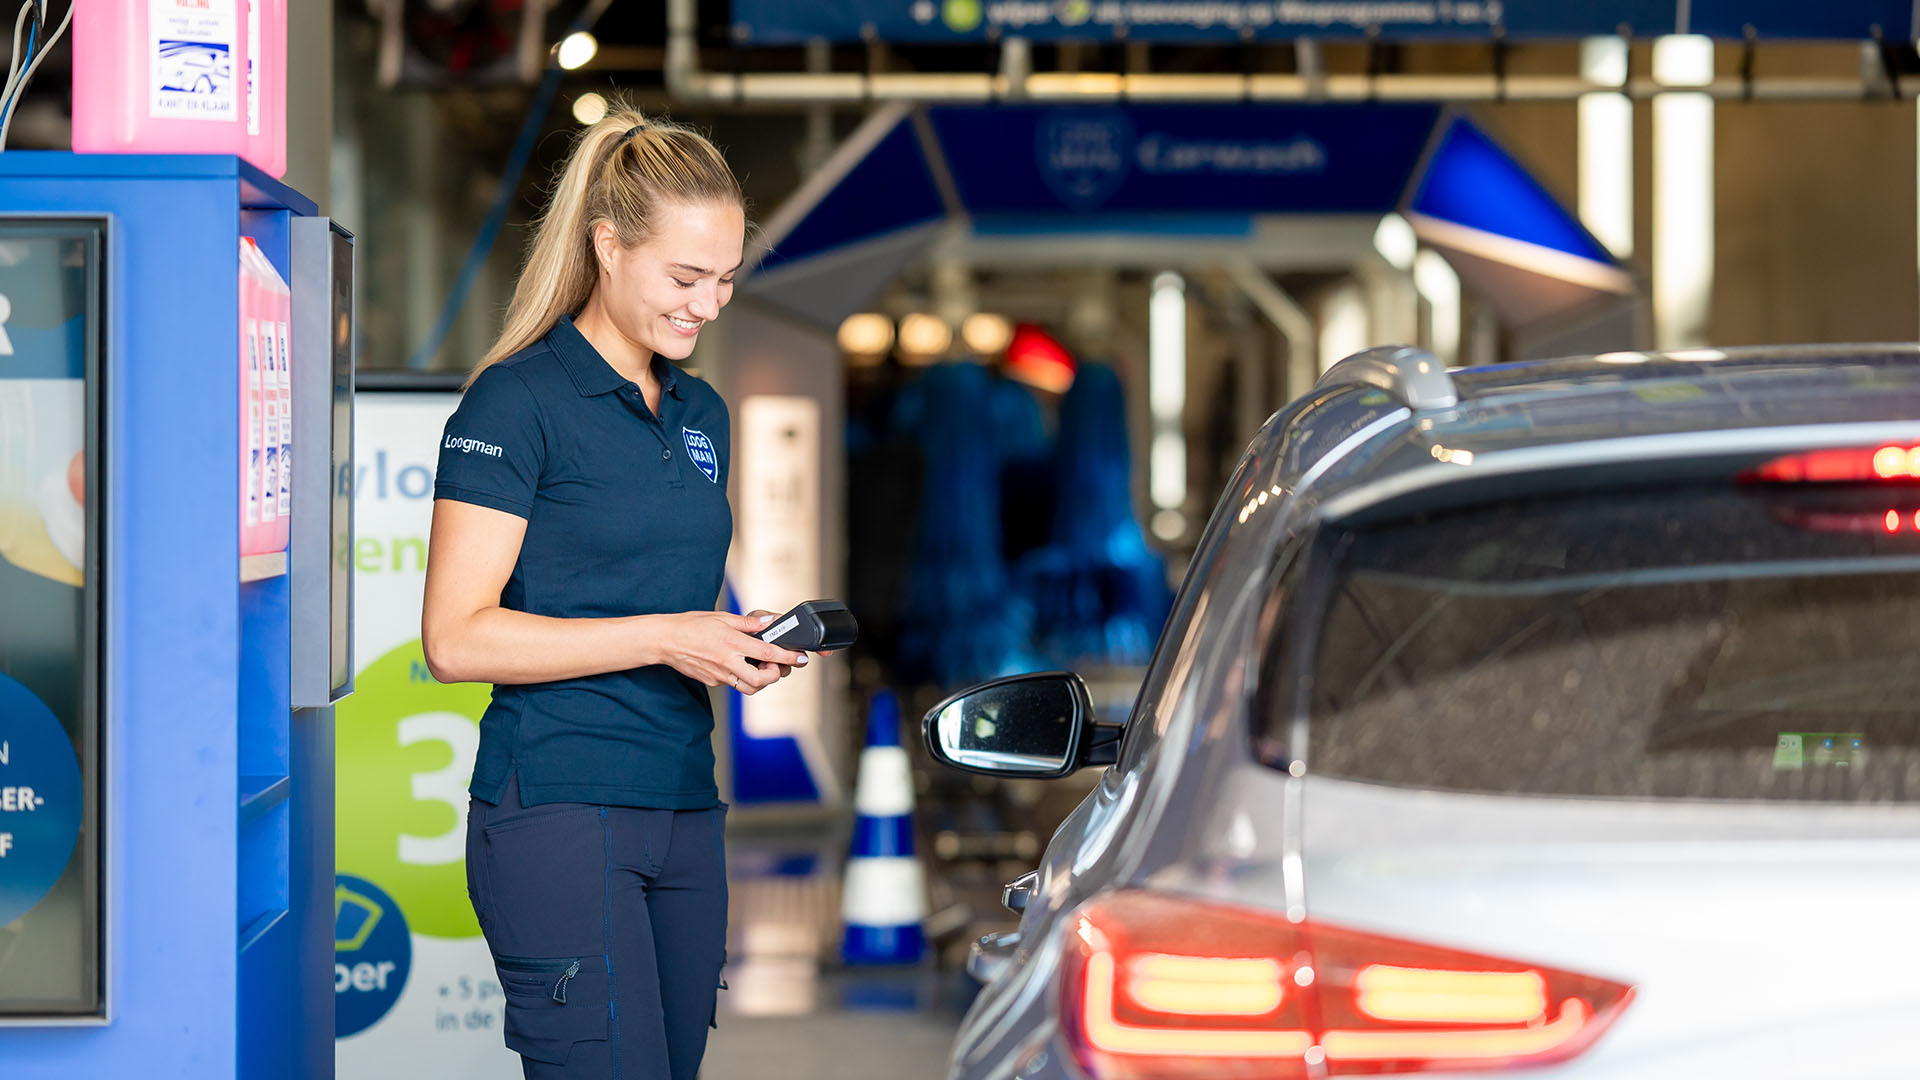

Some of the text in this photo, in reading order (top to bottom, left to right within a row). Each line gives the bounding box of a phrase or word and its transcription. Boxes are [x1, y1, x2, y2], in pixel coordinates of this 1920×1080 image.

[444, 434, 503, 458] Loogman
[686, 433, 709, 449] LOOG
[690, 448, 714, 465] MAN
